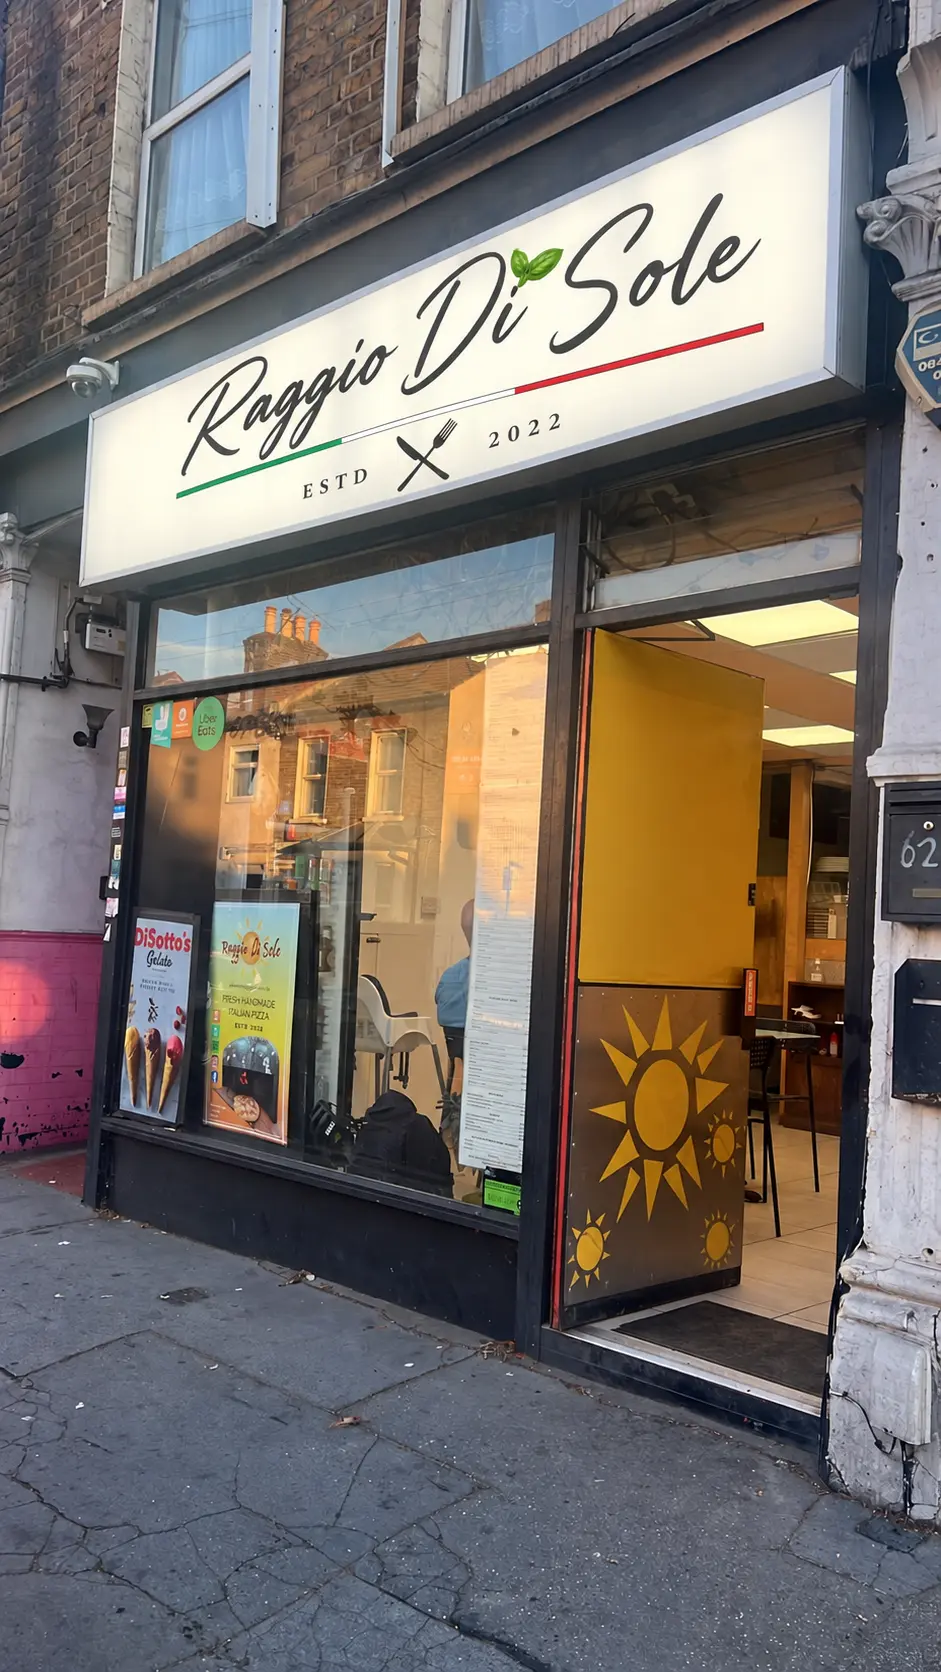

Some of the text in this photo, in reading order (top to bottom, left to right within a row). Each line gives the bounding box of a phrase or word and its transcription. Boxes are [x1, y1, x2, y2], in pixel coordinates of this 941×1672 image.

[180, 193, 762, 477] Raggio Di Sole
[302, 412, 563, 500] ESTD 2022
[197, 725, 216, 737] Eats
[200, 713, 218, 724] Uber
[900, 830, 939, 868] 62
[134, 927, 192, 953] DiSotto's
[250, 937, 261, 957] Di
